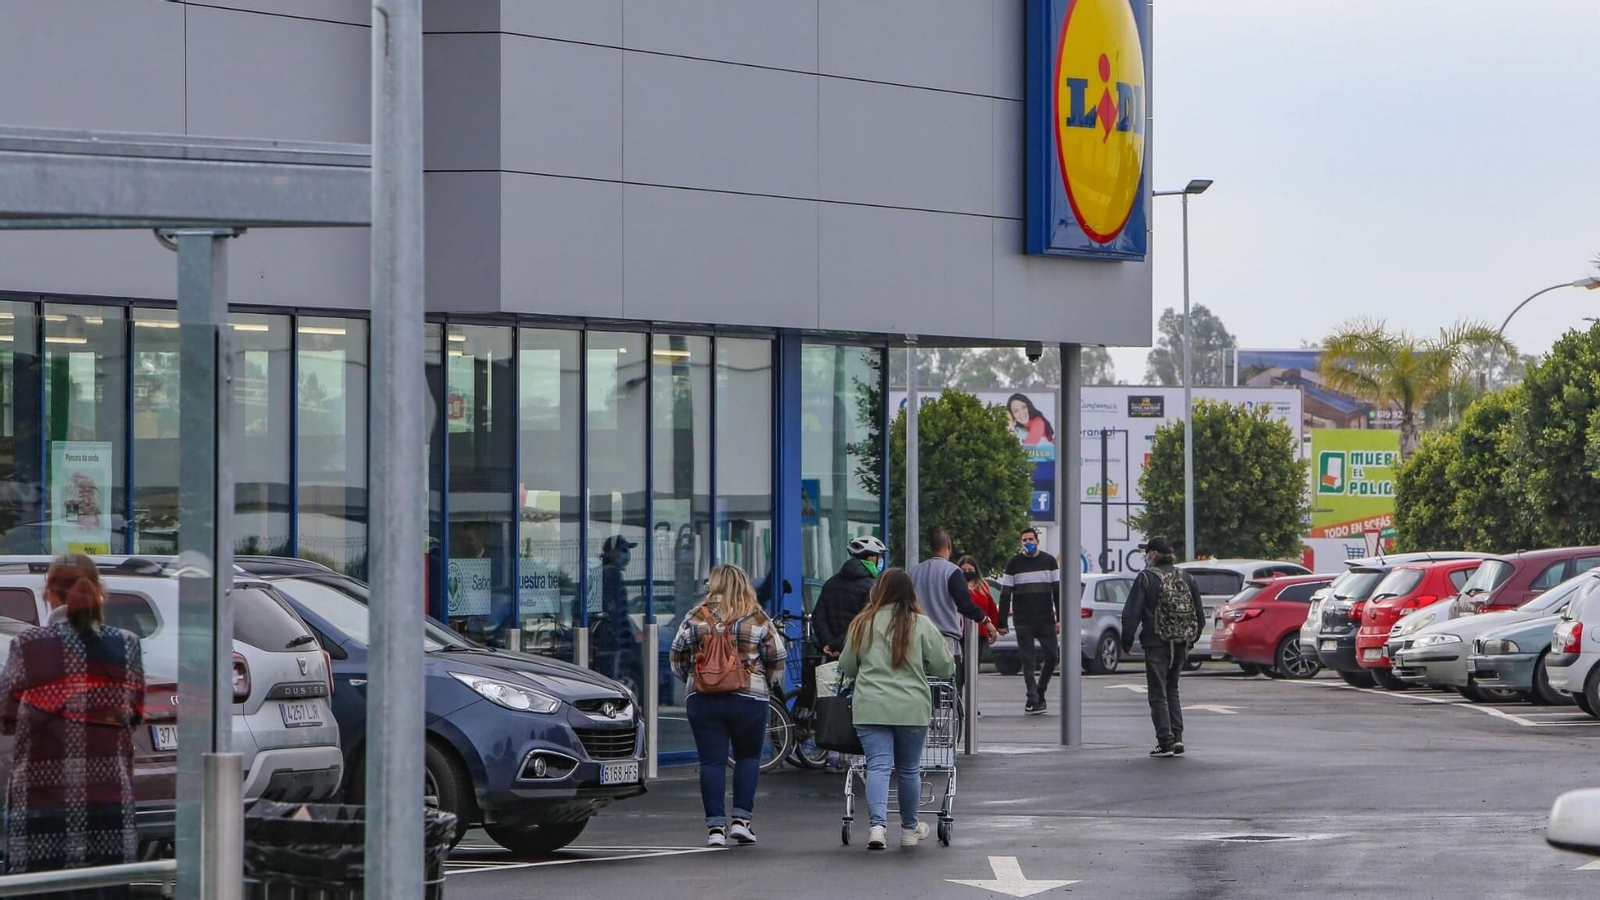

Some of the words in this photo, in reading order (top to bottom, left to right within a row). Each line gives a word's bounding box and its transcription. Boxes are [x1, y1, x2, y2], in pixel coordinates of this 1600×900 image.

[1353, 469, 1363, 477] EL
[1349, 482, 1393, 494] POLIG
[1324, 525, 1348, 538] TODO
[1351, 522, 1362, 533] EN
[518, 572, 545, 589] uestra
[548, 571, 560, 589] tie
[285, 686, 325, 695] DUSTER
[287, 704, 307, 721] 4257
[604, 766, 622, 782] 6168
[624, 765, 638, 780] HFS
